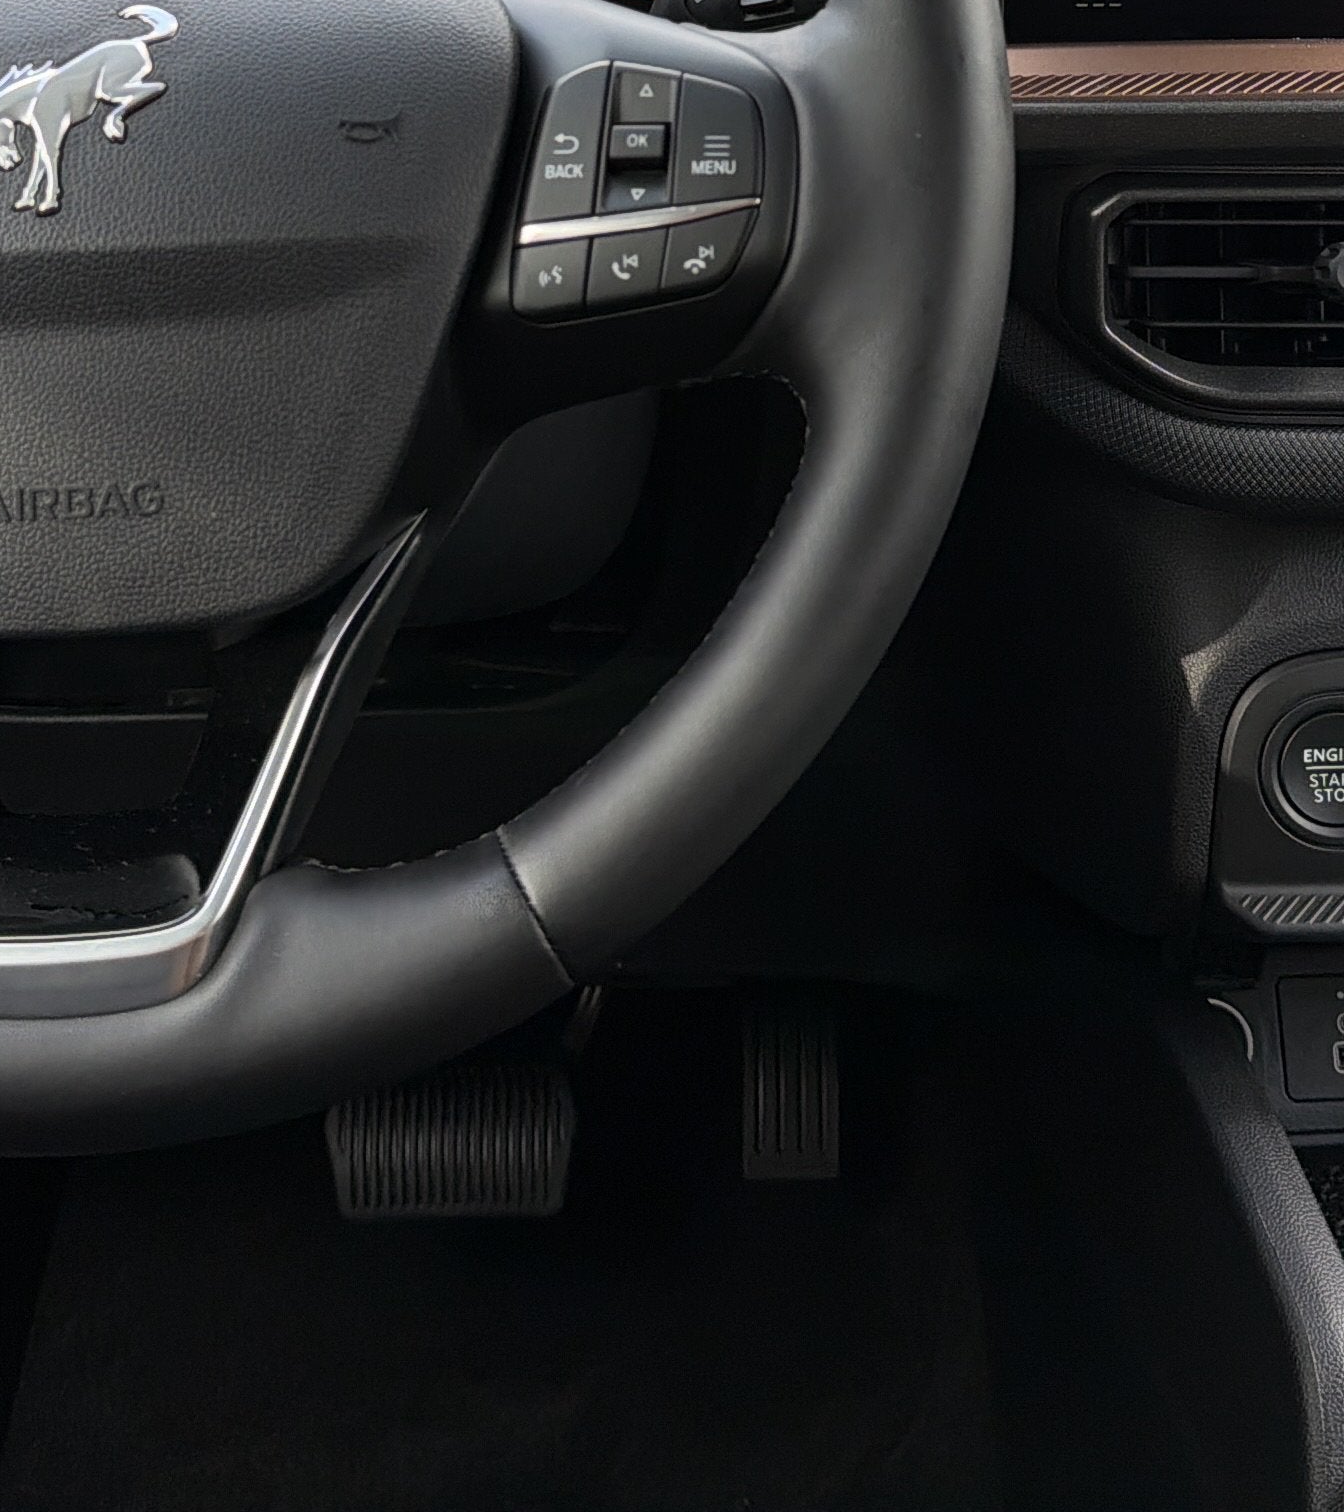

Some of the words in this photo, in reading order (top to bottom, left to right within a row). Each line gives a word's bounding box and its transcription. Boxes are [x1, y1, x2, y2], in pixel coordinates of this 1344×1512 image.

[626, 133, 649, 148] OK
[544, 163, 584, 180] BACK
[690, 159, 737, 176] MENU
